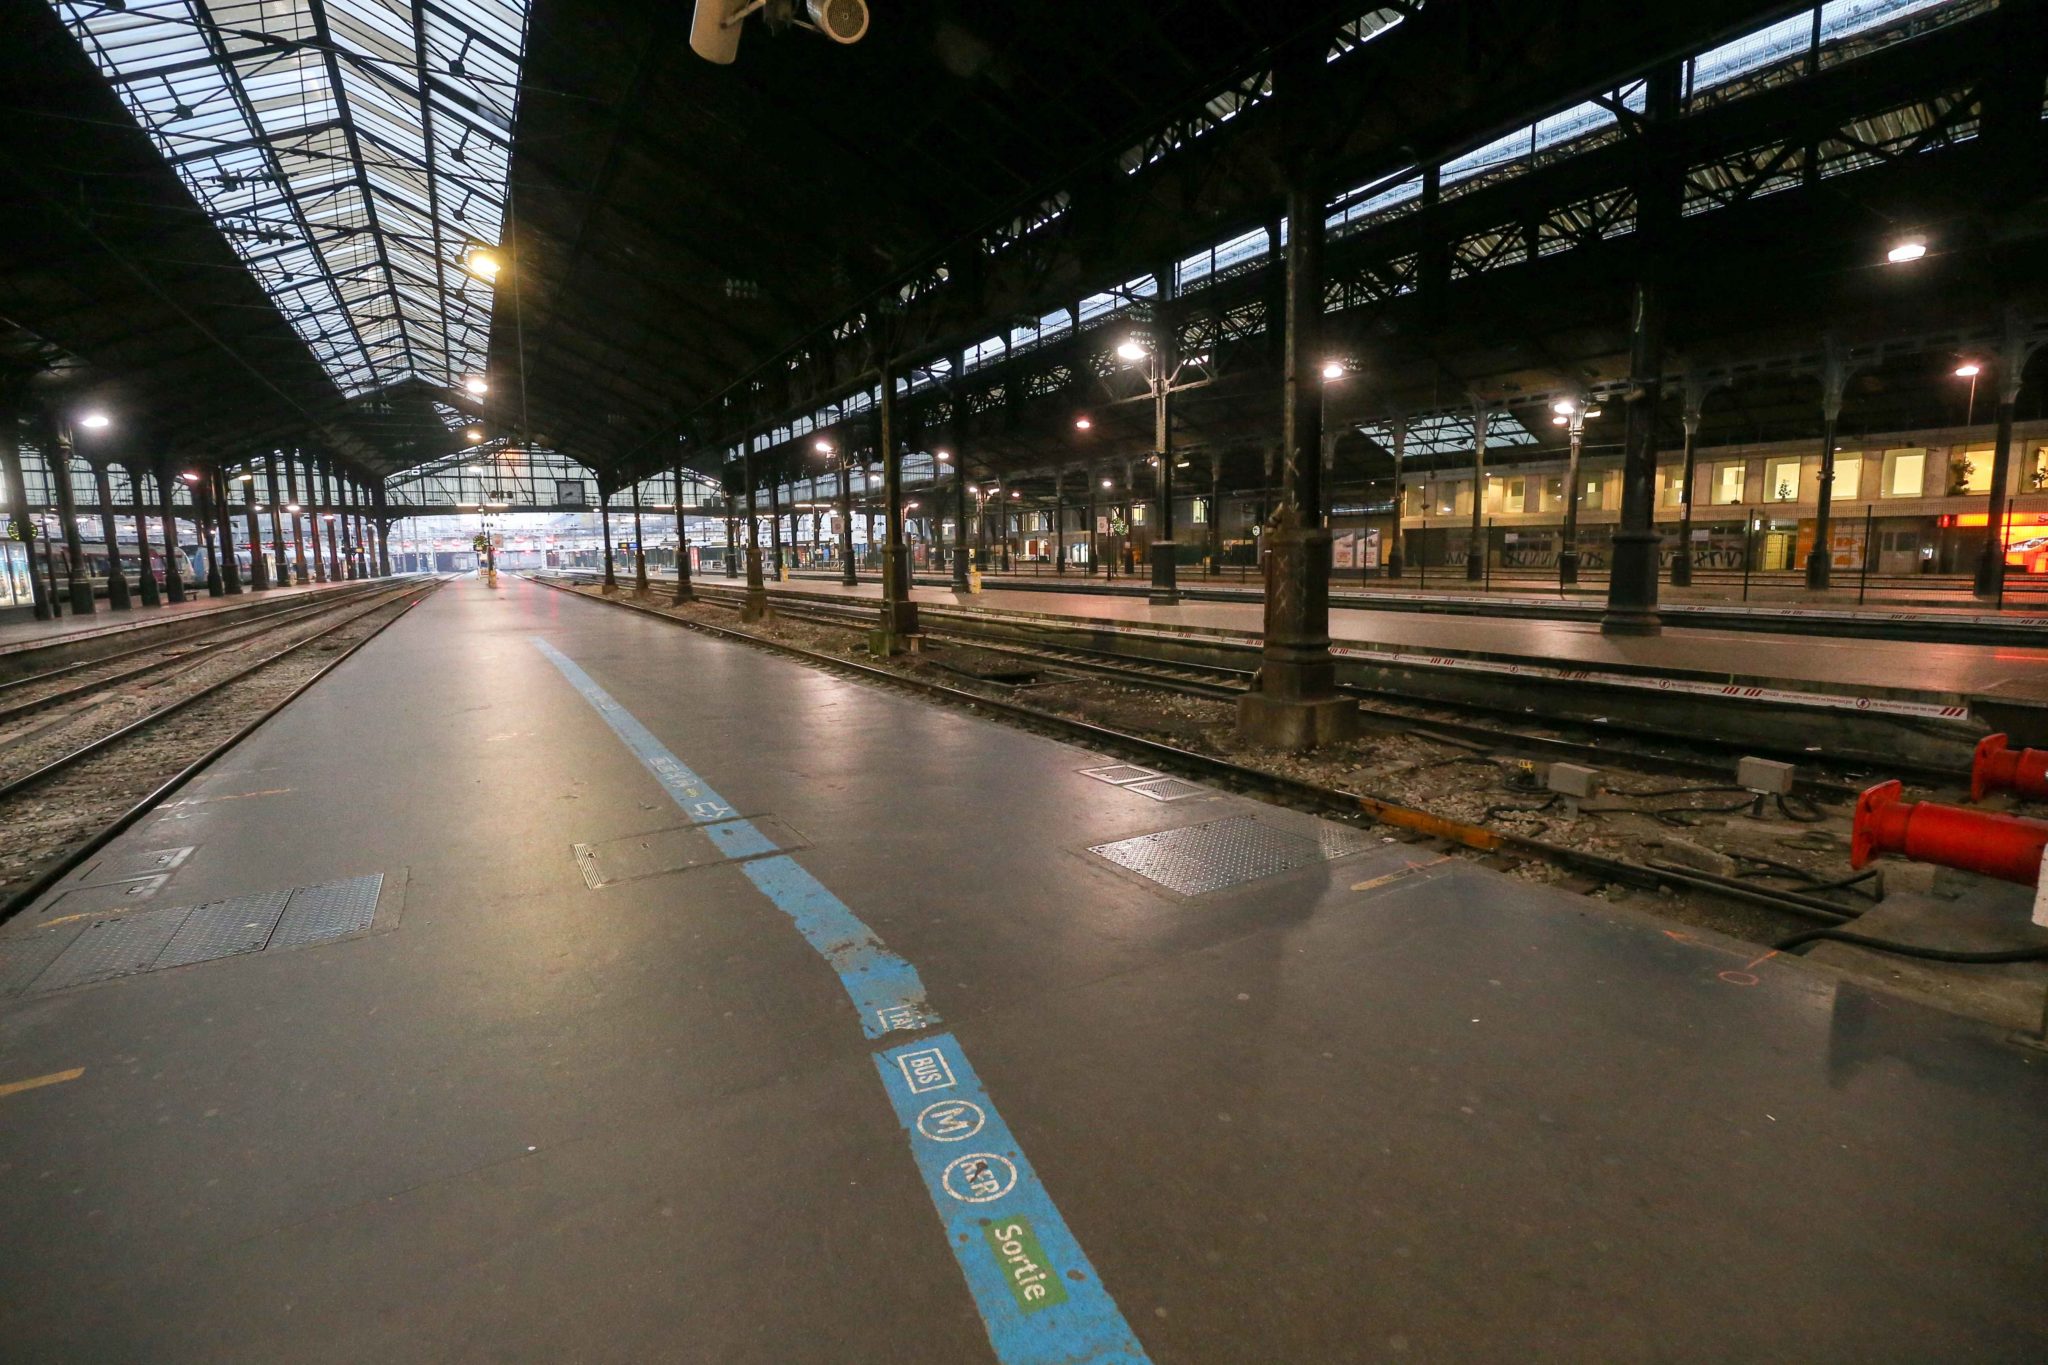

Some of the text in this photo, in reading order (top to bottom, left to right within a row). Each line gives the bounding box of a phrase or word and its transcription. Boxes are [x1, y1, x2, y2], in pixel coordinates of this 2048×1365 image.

[910, 1056, 942, 1084] BUS
[931, 1107, 970, 1133] M
[995, 1224, 1047, 1301] Sortie
